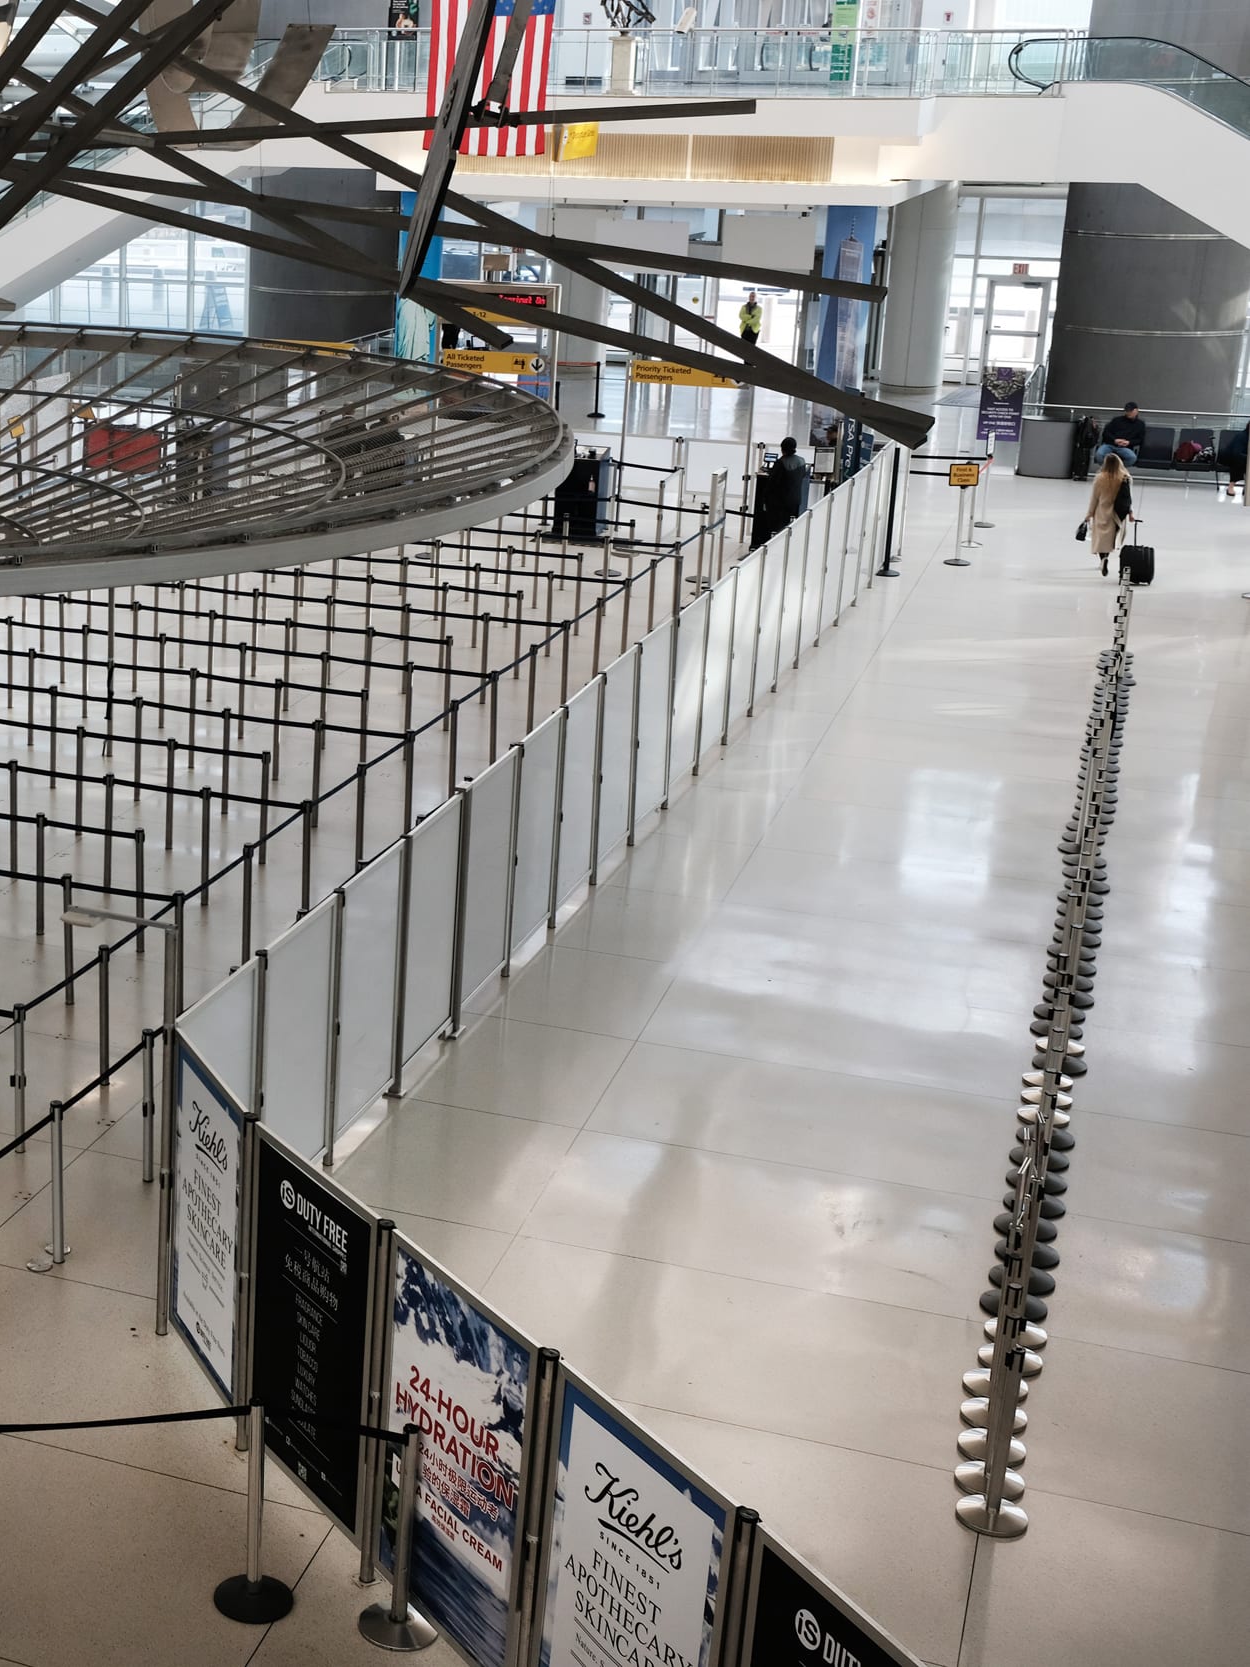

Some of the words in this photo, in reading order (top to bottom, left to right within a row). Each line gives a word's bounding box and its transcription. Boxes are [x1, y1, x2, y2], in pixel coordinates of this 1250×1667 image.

[446, 361, 483, 370] Passengers
[457, 354, 485, 362] Ticketed
[635, 372, 674, 382] Passengers
[636, 364, 661, 374] Priority
[663, 366, 692, 375] Ticketed
[189, 1100, 228, 1170] Kiehl's
[182, 1177, 233, 1254] APOTHECARY
[194, 1168, 221, 1216] FINEST
[297, 1192, 321, 1230] DUTY
[323, 1214, 348, 1253] FREE
[187, 1203, 226, 1270] SKINCARE
[395, 1381, 514, 1511] HYDRATION
[409, 1365, 499, 1463] 24-HOUR
[425, 1493, 460, 1535] FACIAL
[462, 1529, 503, 1571] CREAM
[584, 1462, 682, 1570] Kiehl's
[592, 1549, 661, 1625] FINEST
[599, 1531, 630, 1564] SINCE
[636, 1564, 660, 1590] 1851
[574, 1590, 655, 1667] SKINCA
[823, 1632, 861, 1667] DUT
